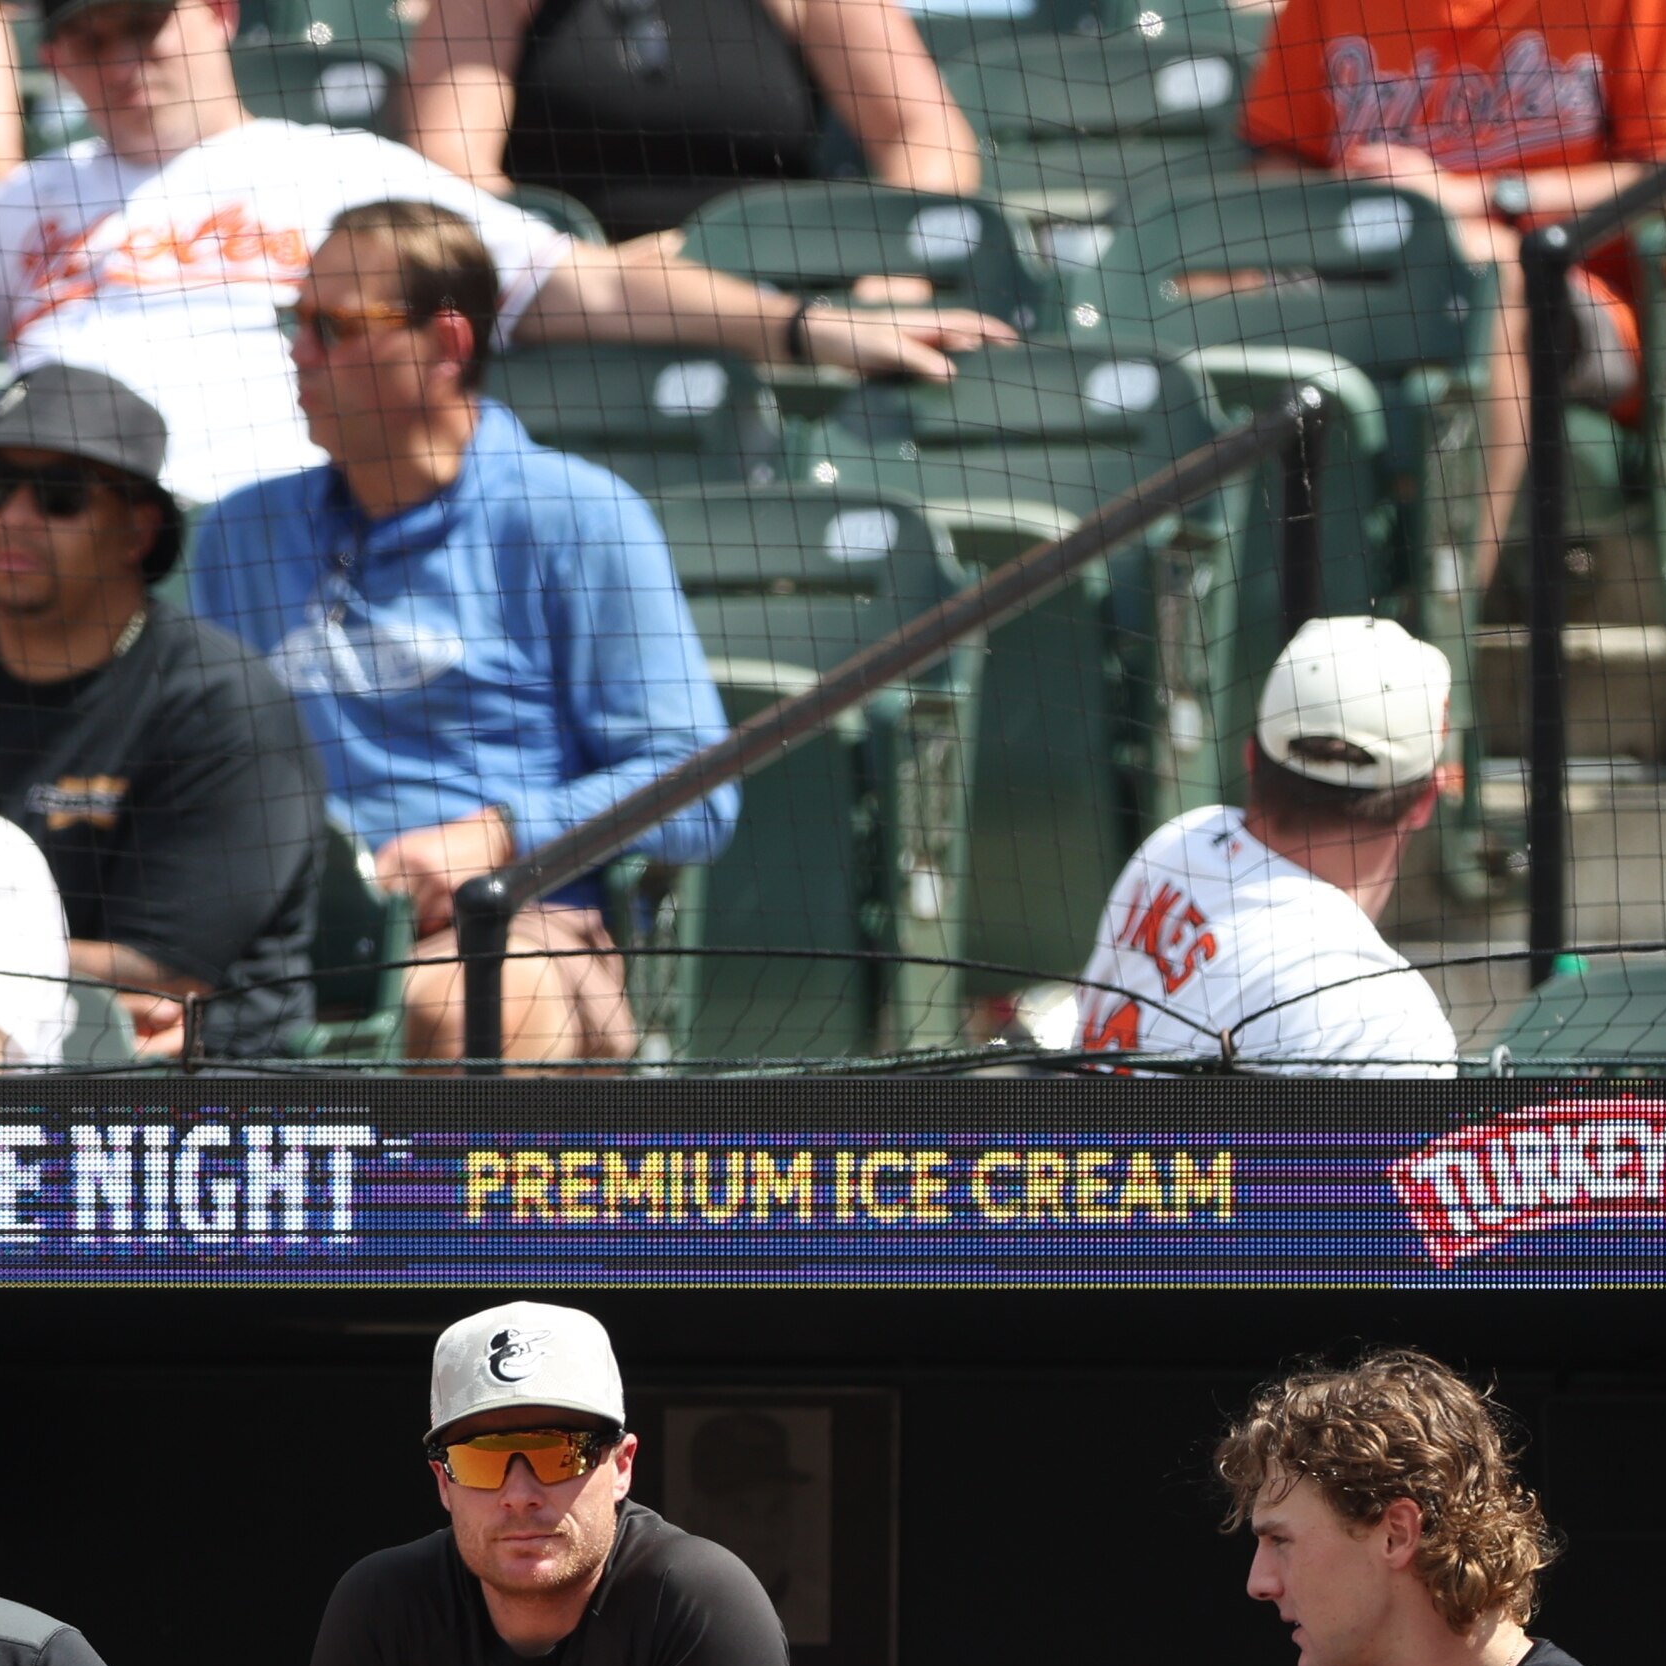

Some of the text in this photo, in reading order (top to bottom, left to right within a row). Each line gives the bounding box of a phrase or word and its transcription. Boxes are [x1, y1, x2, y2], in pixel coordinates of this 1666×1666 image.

[71, 1124, 377, 1243] NIGHT
[465, 1150, 1237, 1222] PREMIUM ICE CREAM
